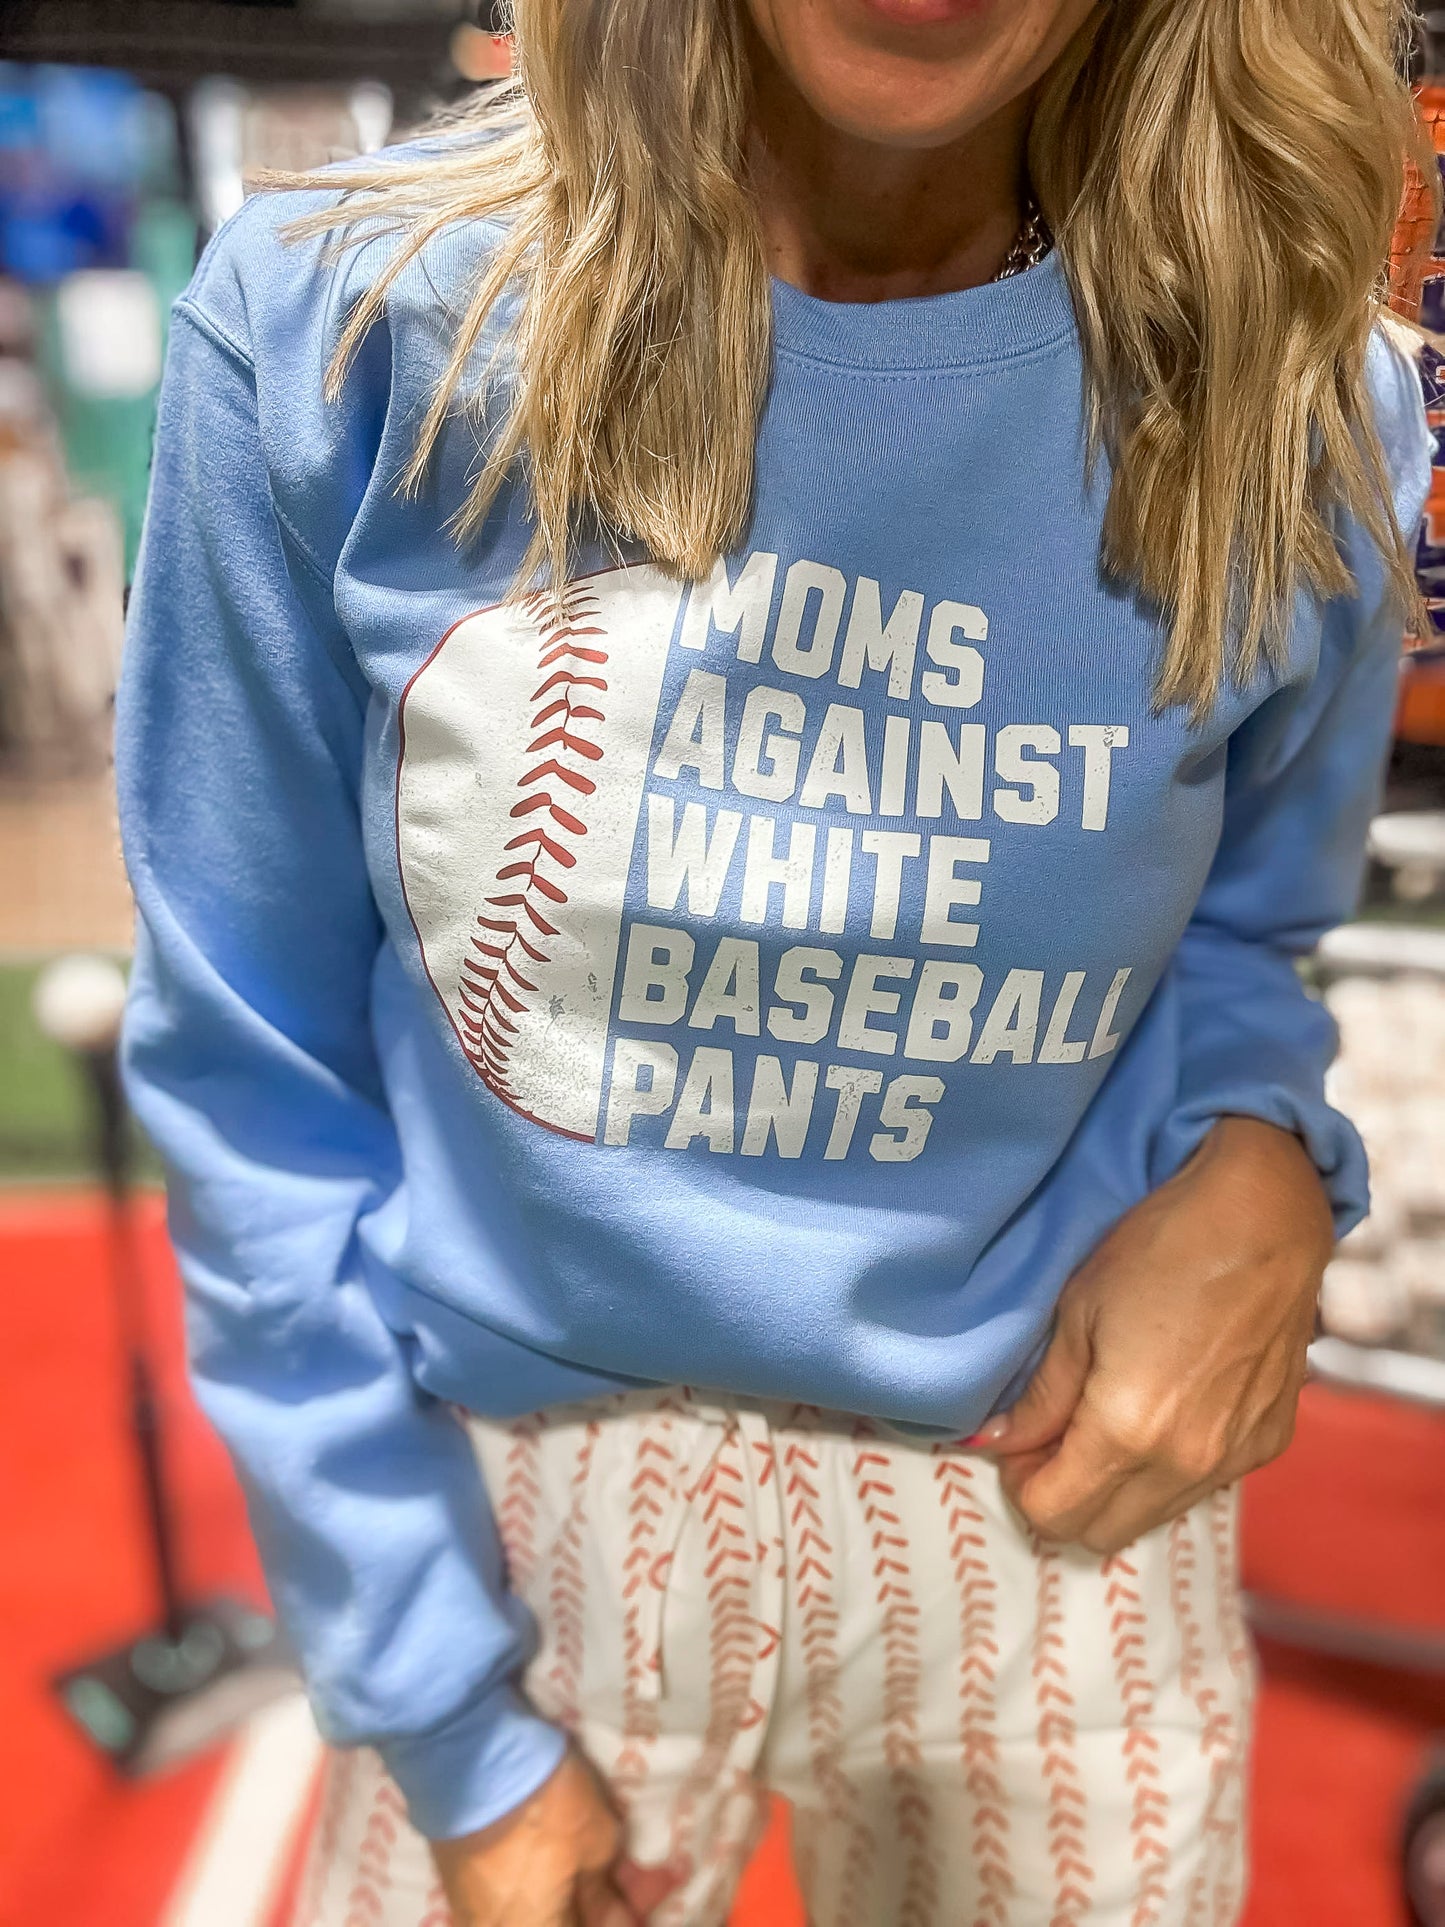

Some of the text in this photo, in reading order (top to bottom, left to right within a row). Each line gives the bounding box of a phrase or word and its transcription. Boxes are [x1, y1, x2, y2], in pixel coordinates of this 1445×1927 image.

[680, 551, 989, 709] MOMS
[652, 668, 1130, 832] AGAINST
[647, 793, 991, 948] WHITE
[617, 922, 1132, 1065] BASEBALL
[603, 1037, 947, 1163] PANTS
